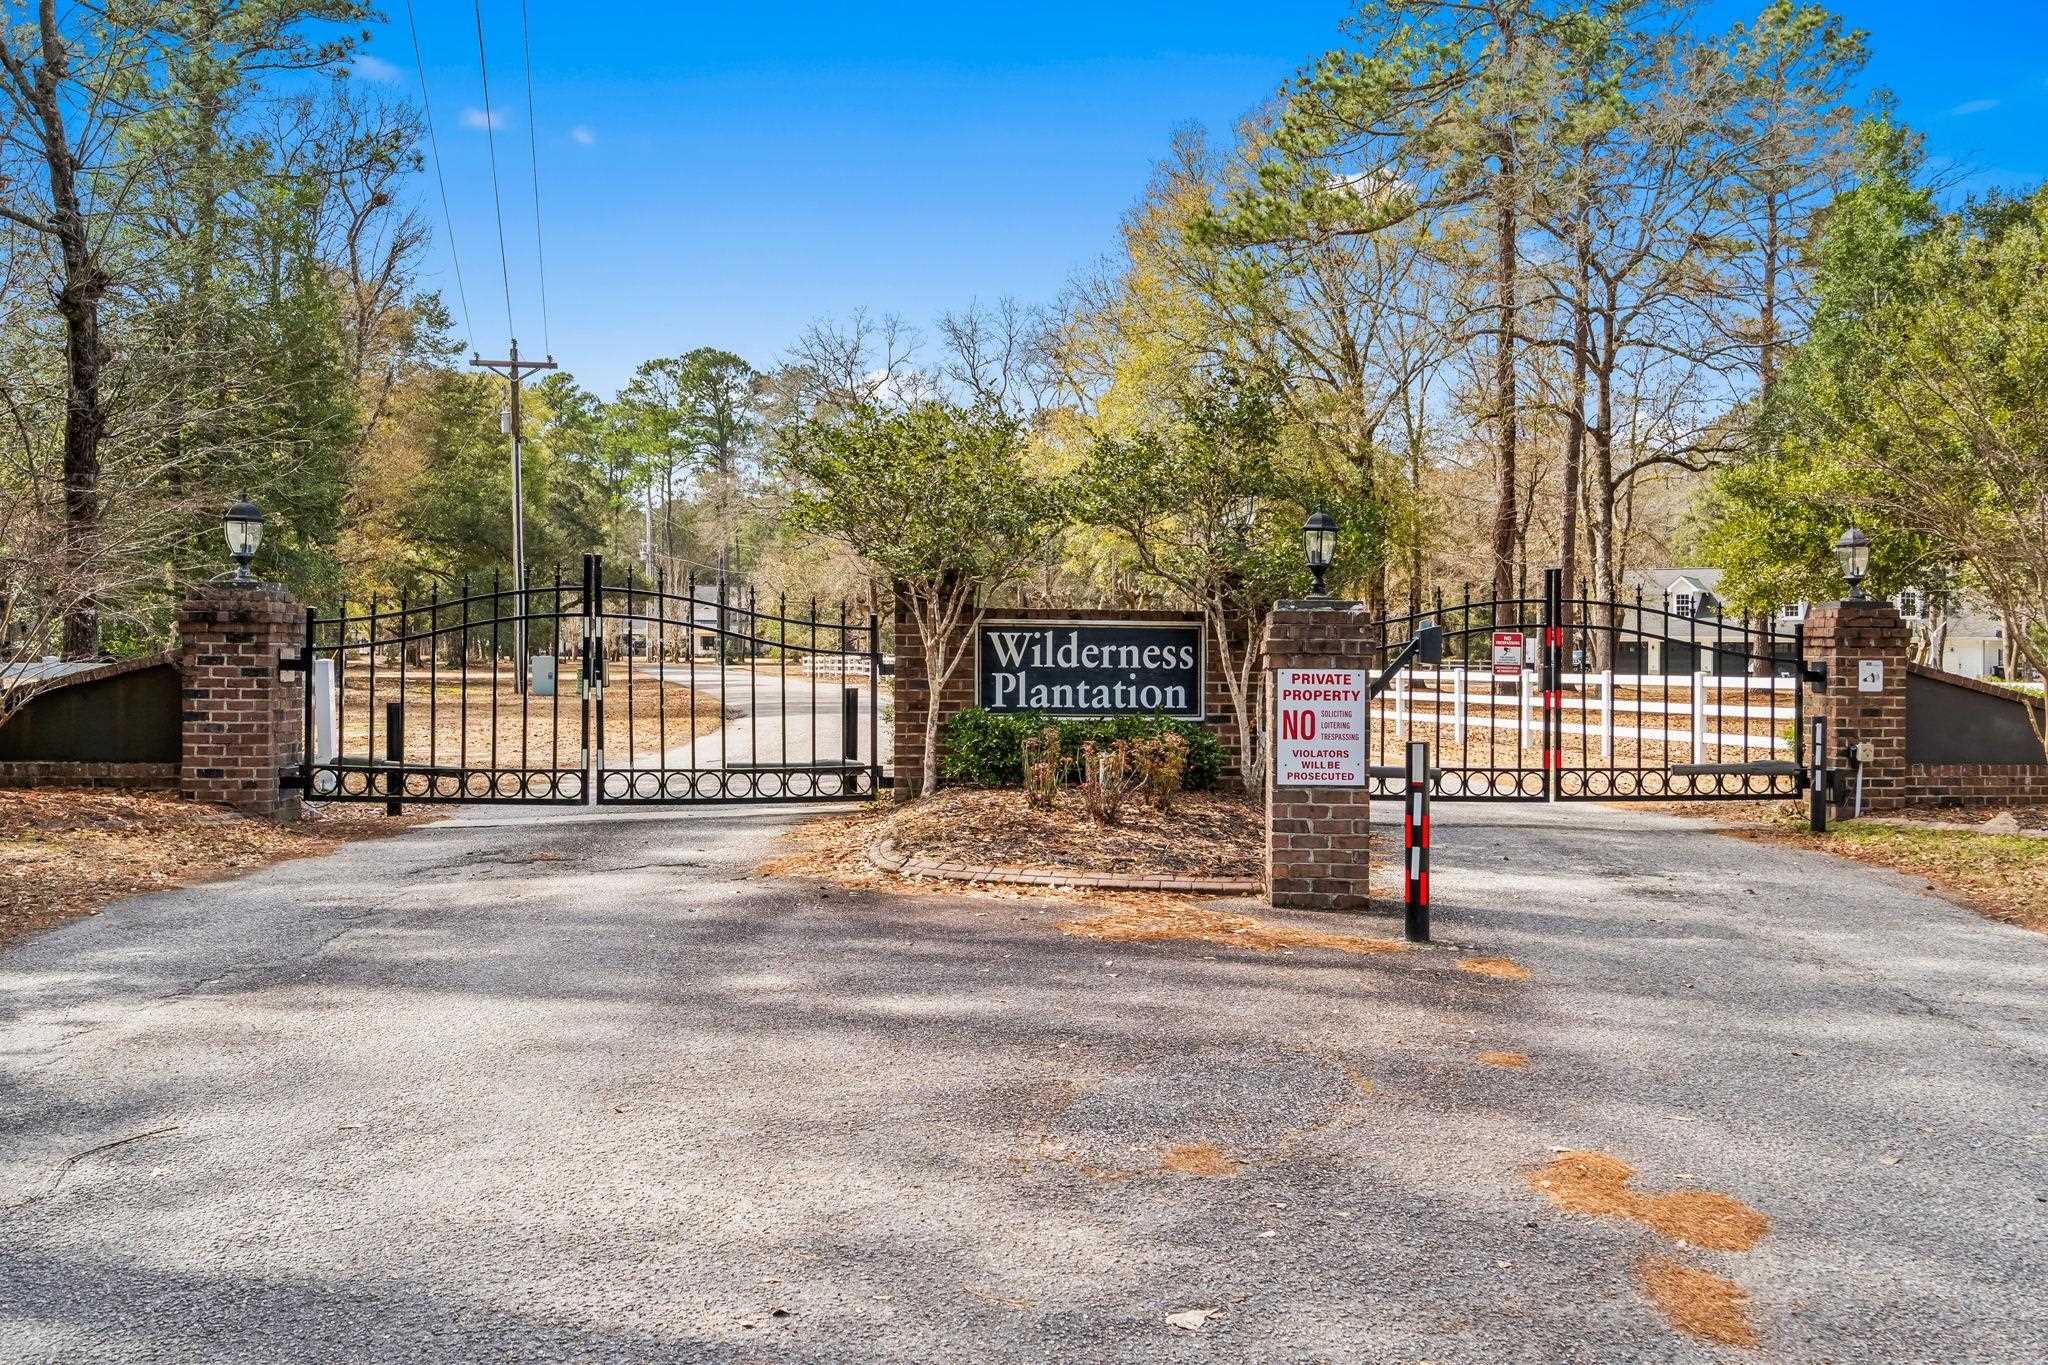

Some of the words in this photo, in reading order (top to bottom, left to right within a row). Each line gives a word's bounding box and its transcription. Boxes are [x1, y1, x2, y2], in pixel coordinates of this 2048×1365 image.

[987, 631, 1194, 669] Wilderness
[1291, 673, 1352, 685] PRIVATE
[991, 671, 1188, 709] Plantation
[1283, 689, 1361, 701] PROPERTY
[1320, 710, 1353, 718] SOLICITING
[1282, 709, 1316, 740] NO
[1320, 733, 1360, 741] TRESPASSING
[1292, 749, 1350, 758] VIOLATORS
[1301, 761, 1327, 769] WILL
[1327, 761, 1341, 769] BE
[1287, 772, 1355, 781] PROSECUTED
